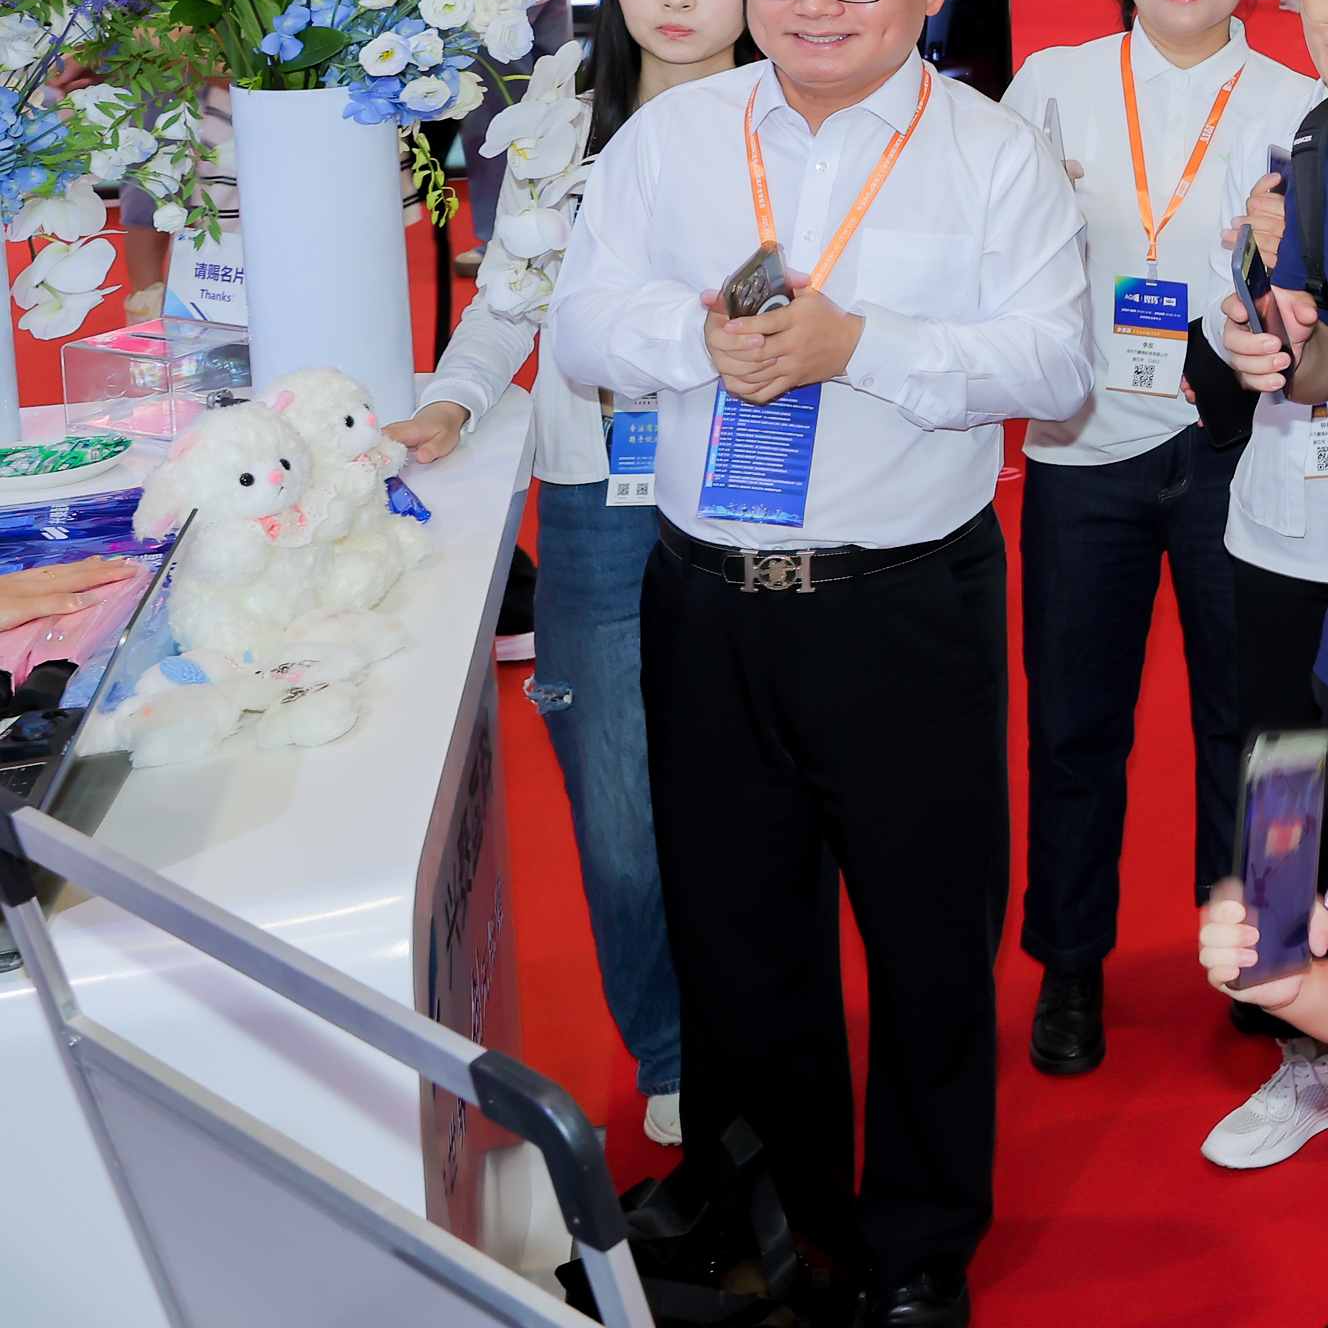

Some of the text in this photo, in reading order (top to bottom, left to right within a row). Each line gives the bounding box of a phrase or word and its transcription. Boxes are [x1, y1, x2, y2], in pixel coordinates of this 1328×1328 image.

[194, 262, 245, 285] 请赐名片
[200, 288, 232, 303] Thanks
